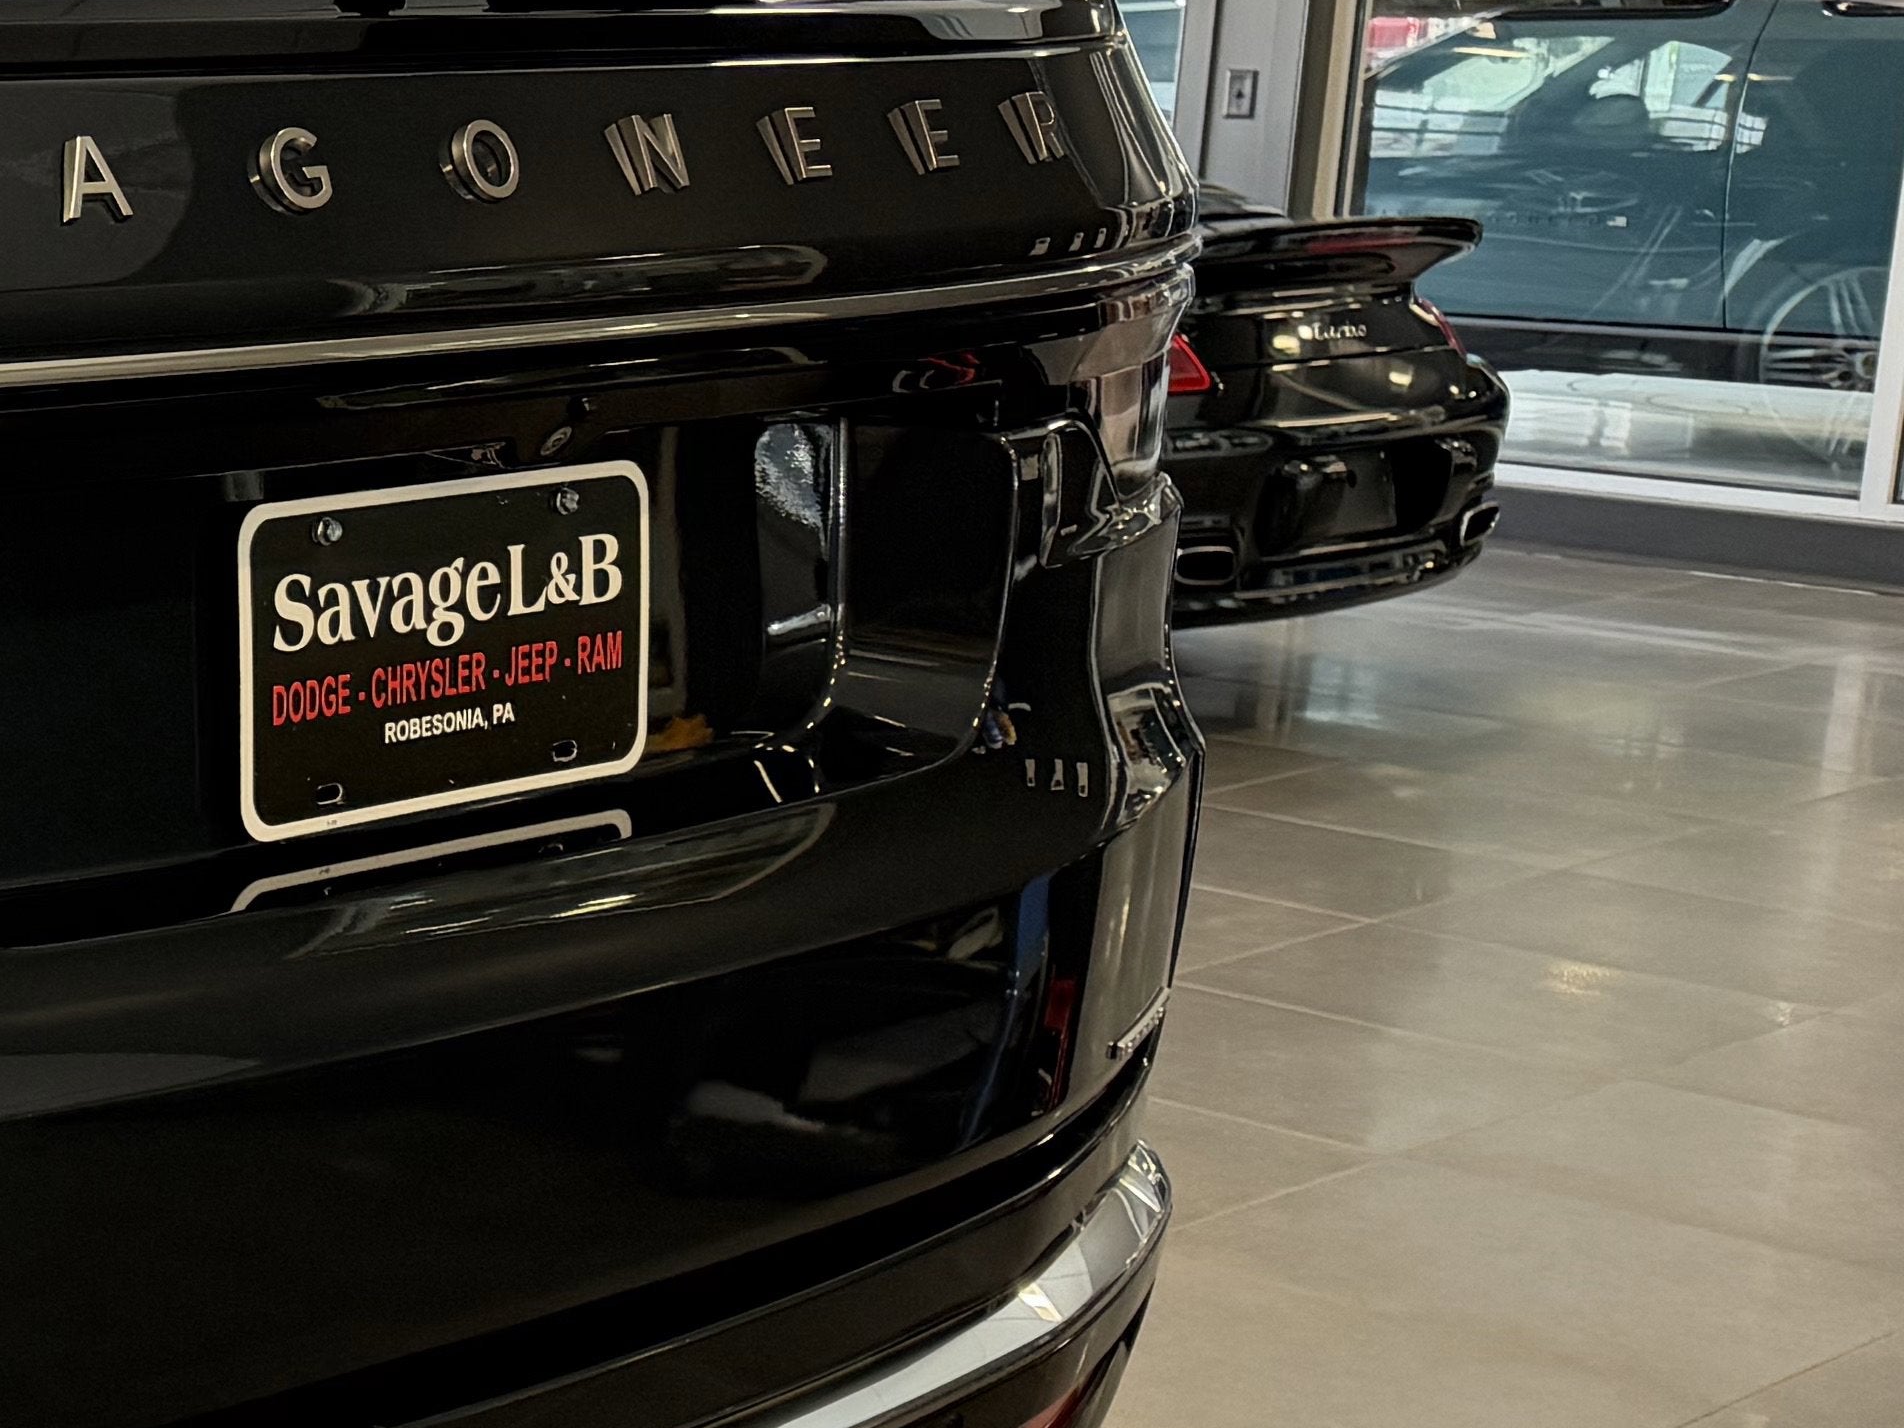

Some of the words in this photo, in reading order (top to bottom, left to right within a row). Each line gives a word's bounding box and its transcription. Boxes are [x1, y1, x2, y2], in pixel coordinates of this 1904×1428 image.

[271, 672, 352, 727] DODGE
[371, 651, 486, 709] CHRYSLER
[504, 639, 559, 686] JEEP
[577, 630, 624, 674] RAM
[383, 706, 489, 745] ROBESONIA,
[492, 701, 516, 725] PA
